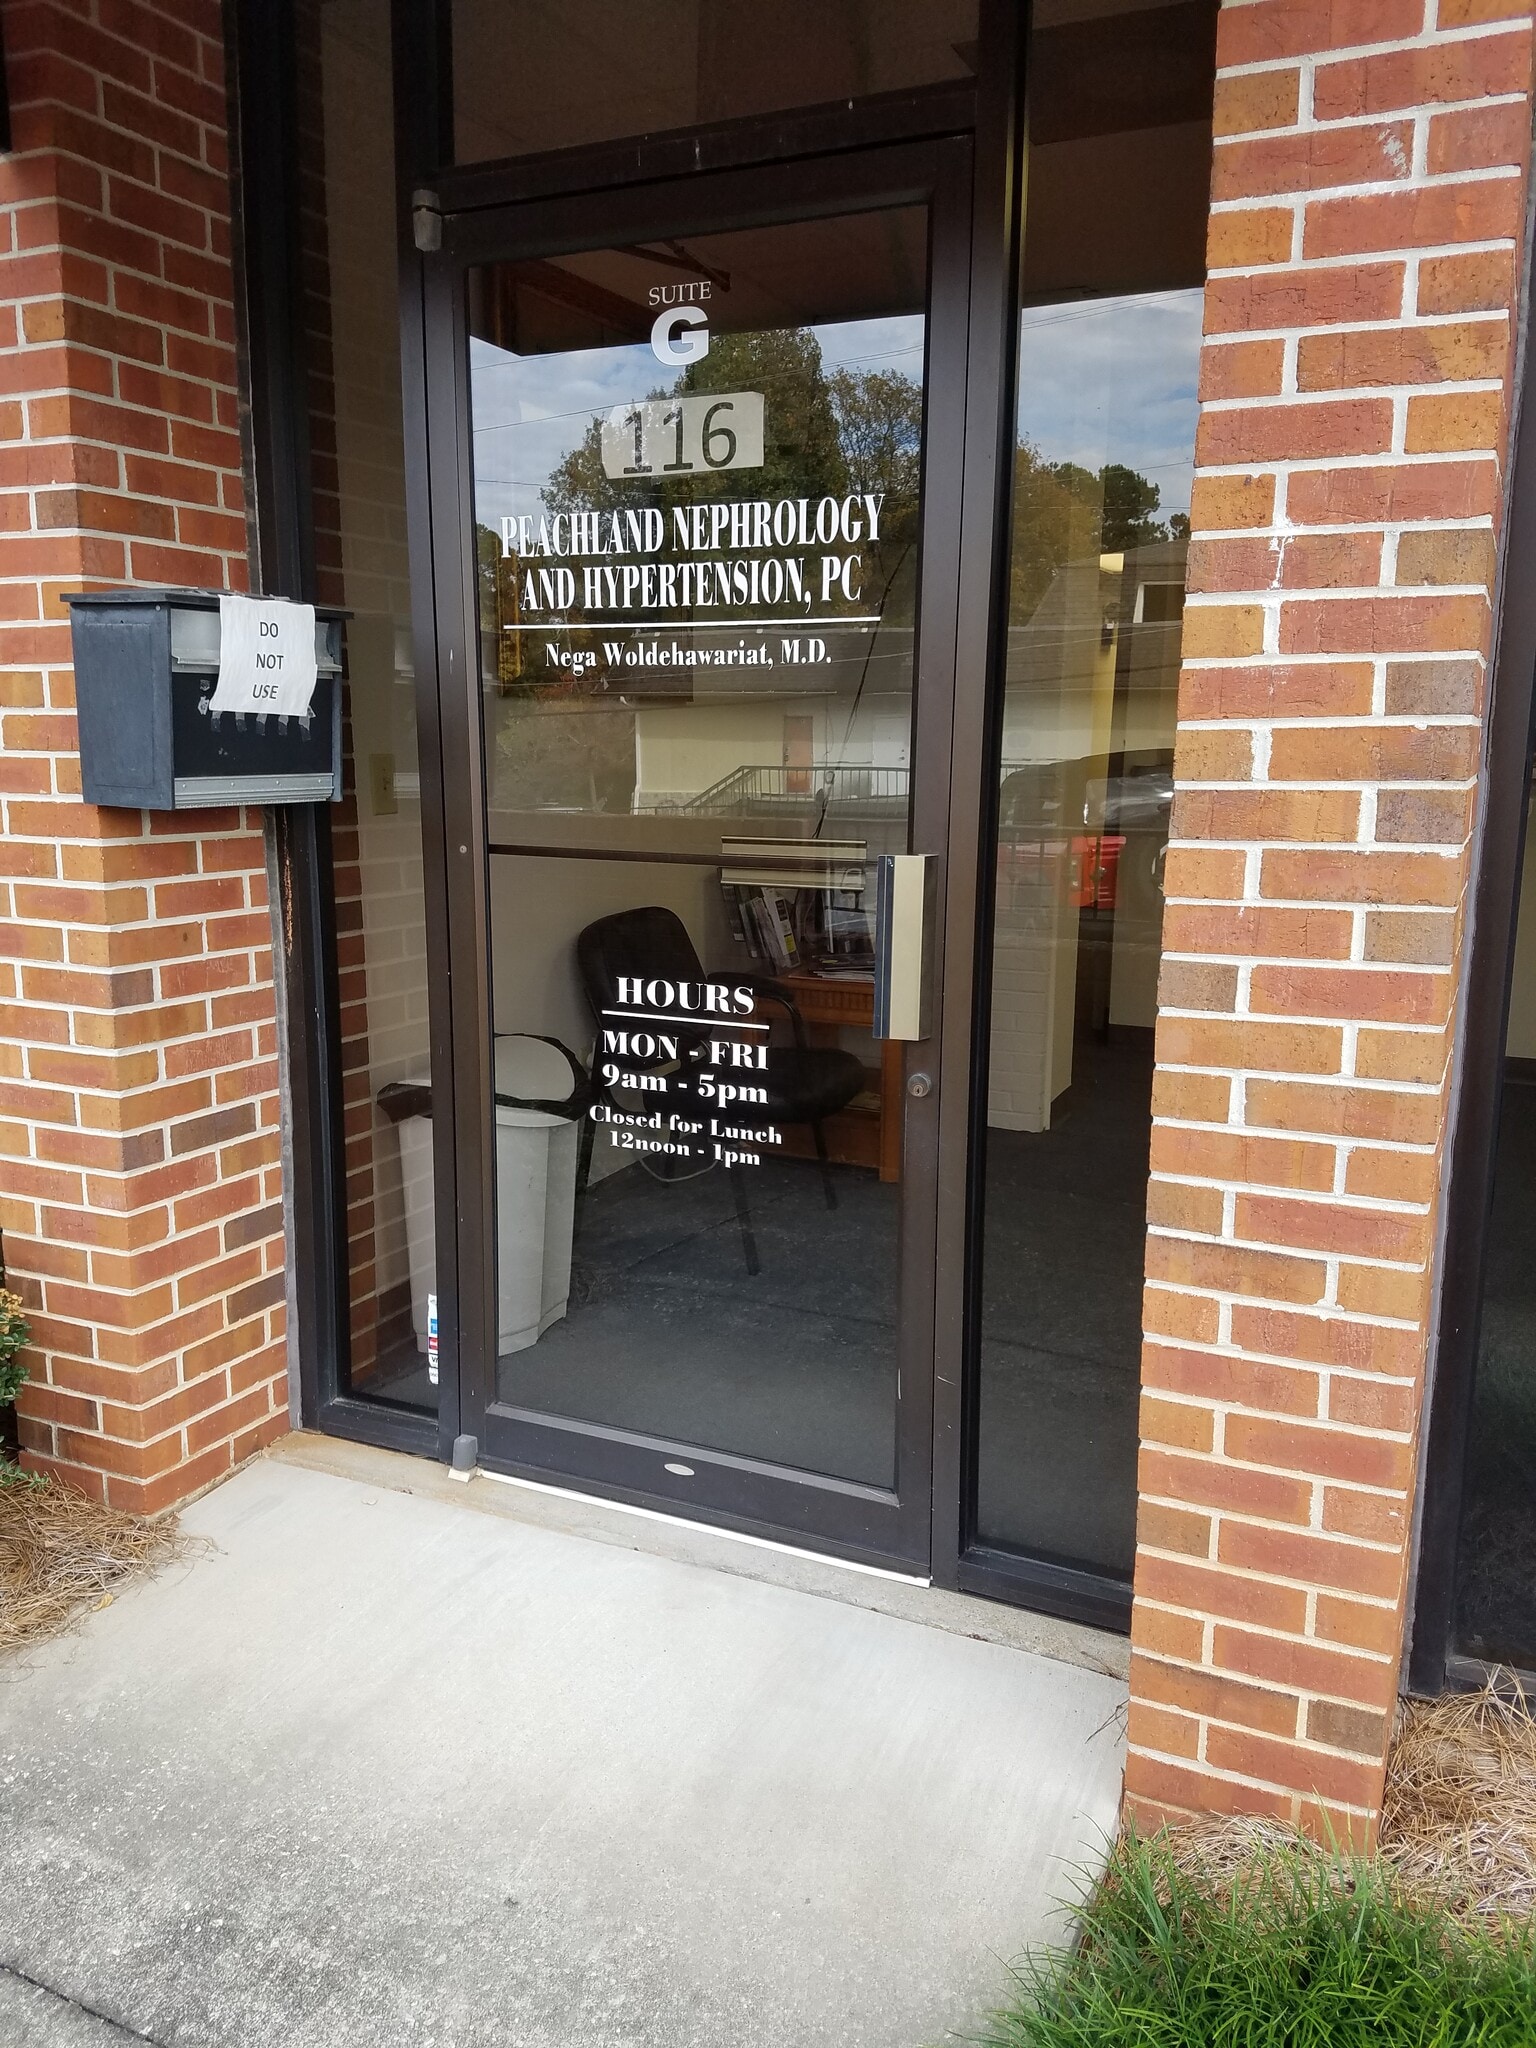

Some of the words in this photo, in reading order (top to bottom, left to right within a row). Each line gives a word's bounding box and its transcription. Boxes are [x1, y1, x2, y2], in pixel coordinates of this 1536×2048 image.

[648, 280, 712, 306] SUITE
[650, 305, 710, 366] G
[622, 401, 737, 475] 116
[500, 508, 664, 559] PEACHLAND
[672, 494, 885, 551] NEPHROLOGY
[521, 567, 575, 611] AND
[583, 557, 812, 614] HYPERTENSION,
[821, 555, 863, 602] PC
[260, 621, 279, 638] DO
[256, 653, 284, 670] NOT
[545, 643, 597, 677] Nega
[603, 640, 774, 670] Woldehawariat,
[781, 638, 832, 664] M.D.
[252, 684, 278, 699] USE
[616, 976, 755, 1015] HOURS
[602, 1030, 679, 1060] MON
[709, 1041, 770, 1070] FRI
[602, 1063, 668, 1093] 9am
[697, 1074, 769, 1109] 5pm
[589, 1105, 662, 1129] Closed
[669, 1115, 704, 1134] for
[710, 1119, 782, 1145] Lunch
[609, 1131, 690, 1157] 12noon
[712, 1144, 760, 1168] 1pm
